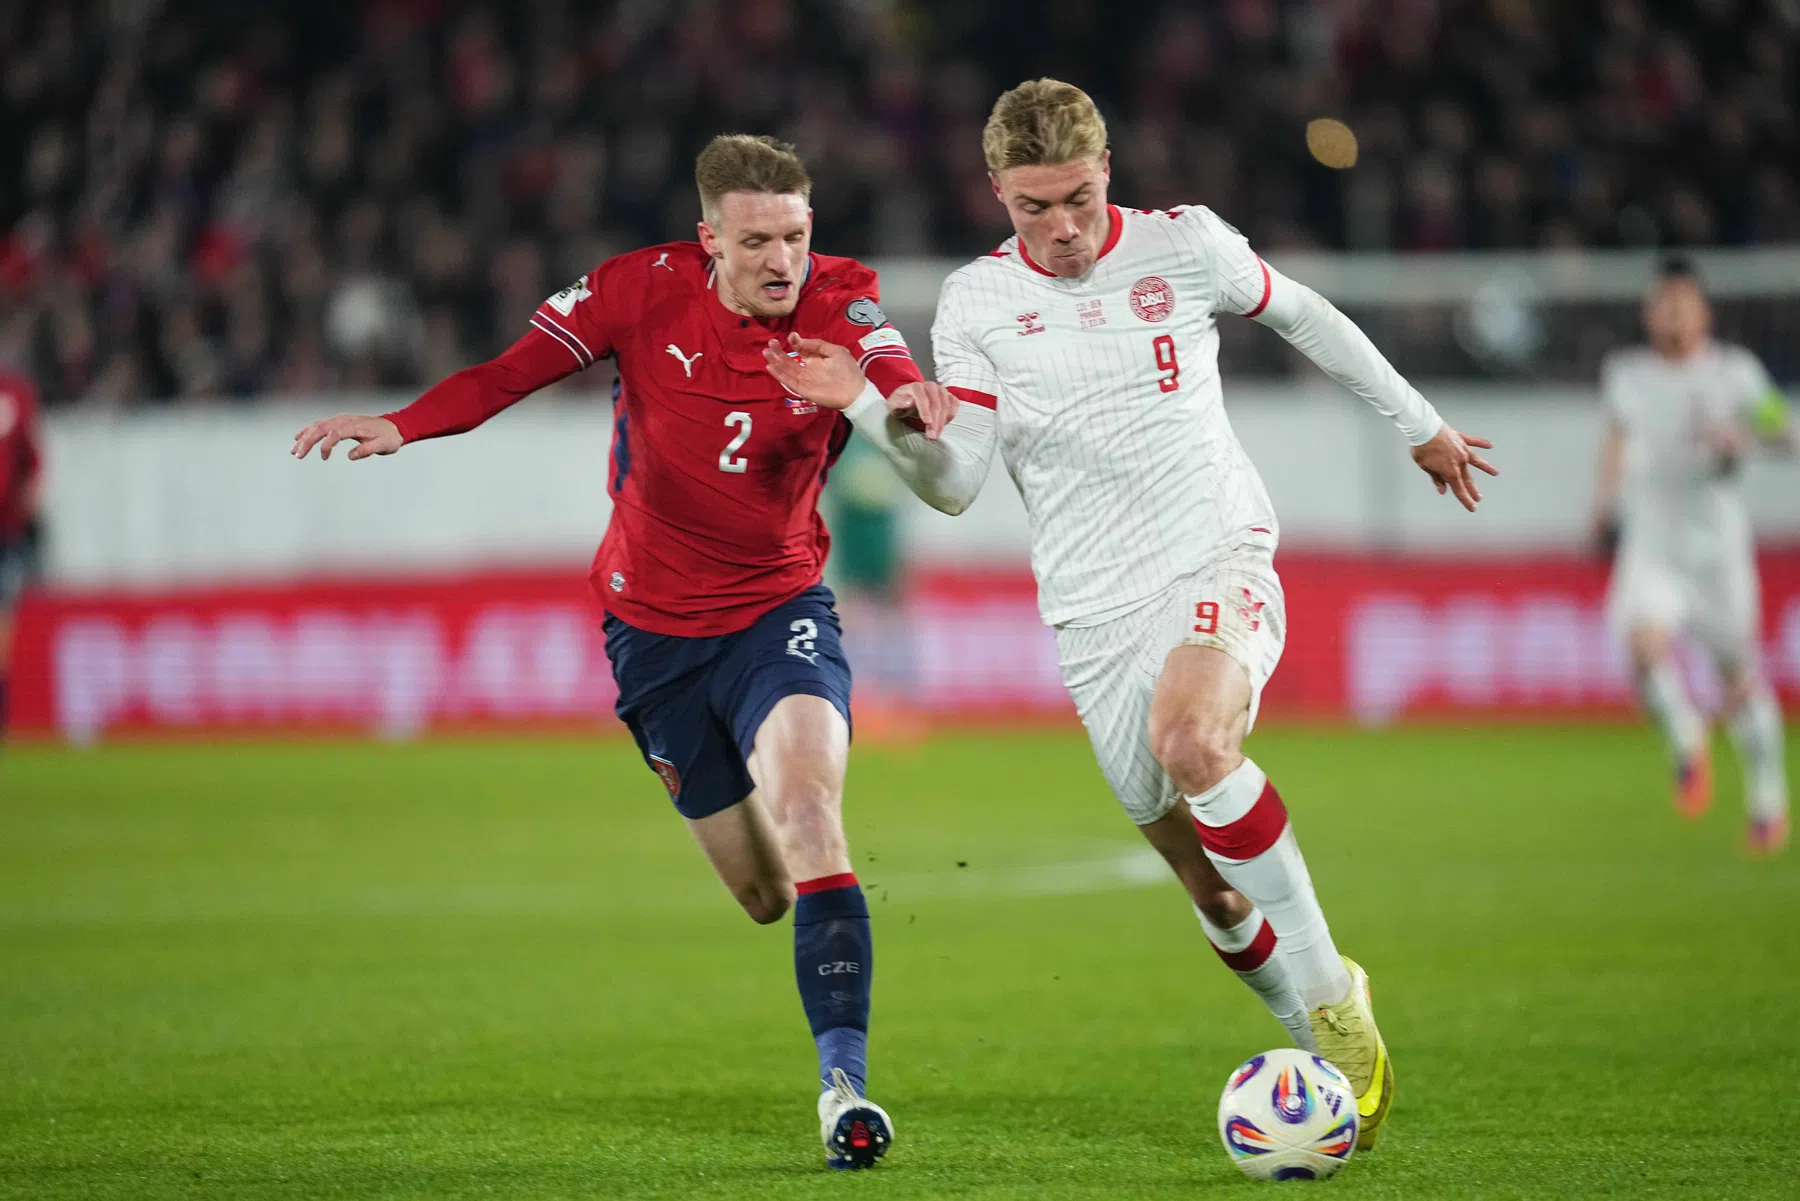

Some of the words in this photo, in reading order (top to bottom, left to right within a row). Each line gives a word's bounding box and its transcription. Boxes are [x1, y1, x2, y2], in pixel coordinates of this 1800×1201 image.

[1152, 335, 1179, 393] 9
[719, 411, 753, 474] 2
[787, 618, 818, 650] 2
[1194, 601, 1219, 635] 9
[817, 960, 860, 976] CZE
